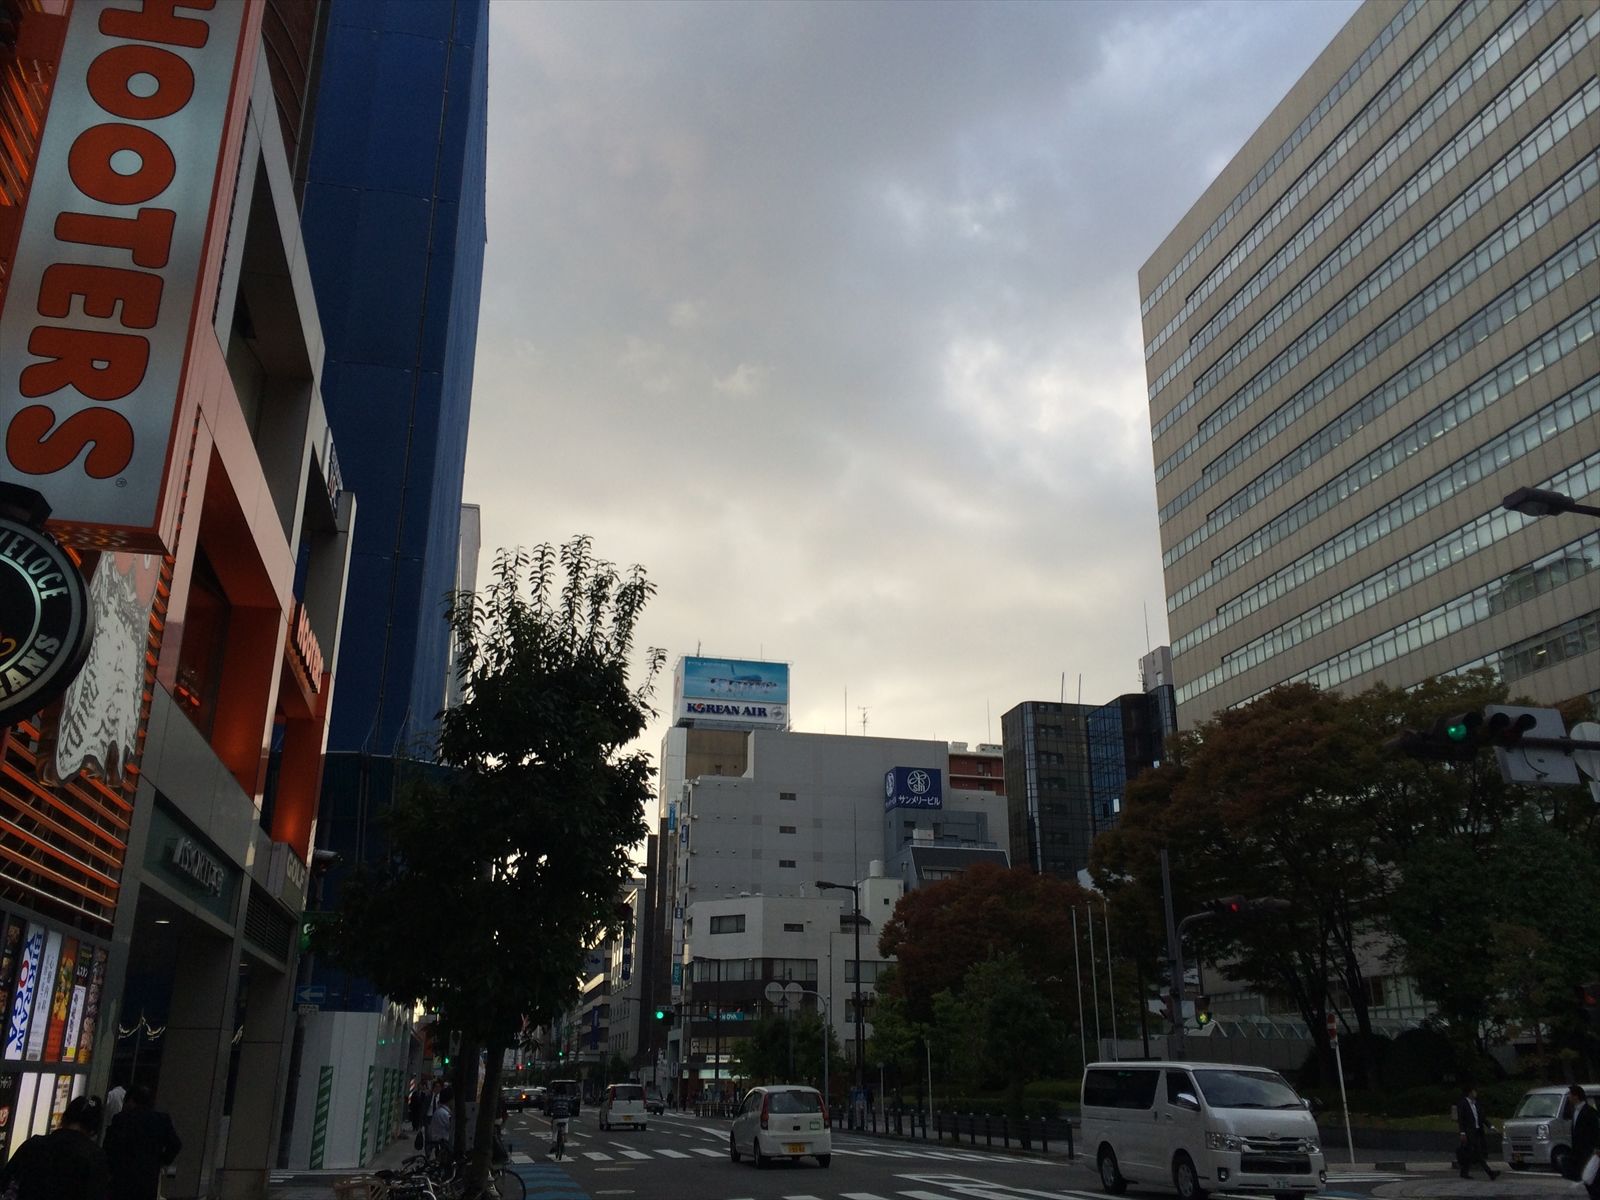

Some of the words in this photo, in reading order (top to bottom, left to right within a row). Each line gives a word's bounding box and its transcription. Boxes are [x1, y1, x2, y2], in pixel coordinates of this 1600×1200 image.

[5, 0, 216, 479] HOOTERS
[687, 702, 740, 716] KOREAN
[742, 706, 767, 717] AIR
[898, 794, 941, 806] サンメリービル
[286, 852, 306, 889] GOLF
[6, 932, 36, 1047] YOGA
[15, 932, 43, 1052] BIKRAM
